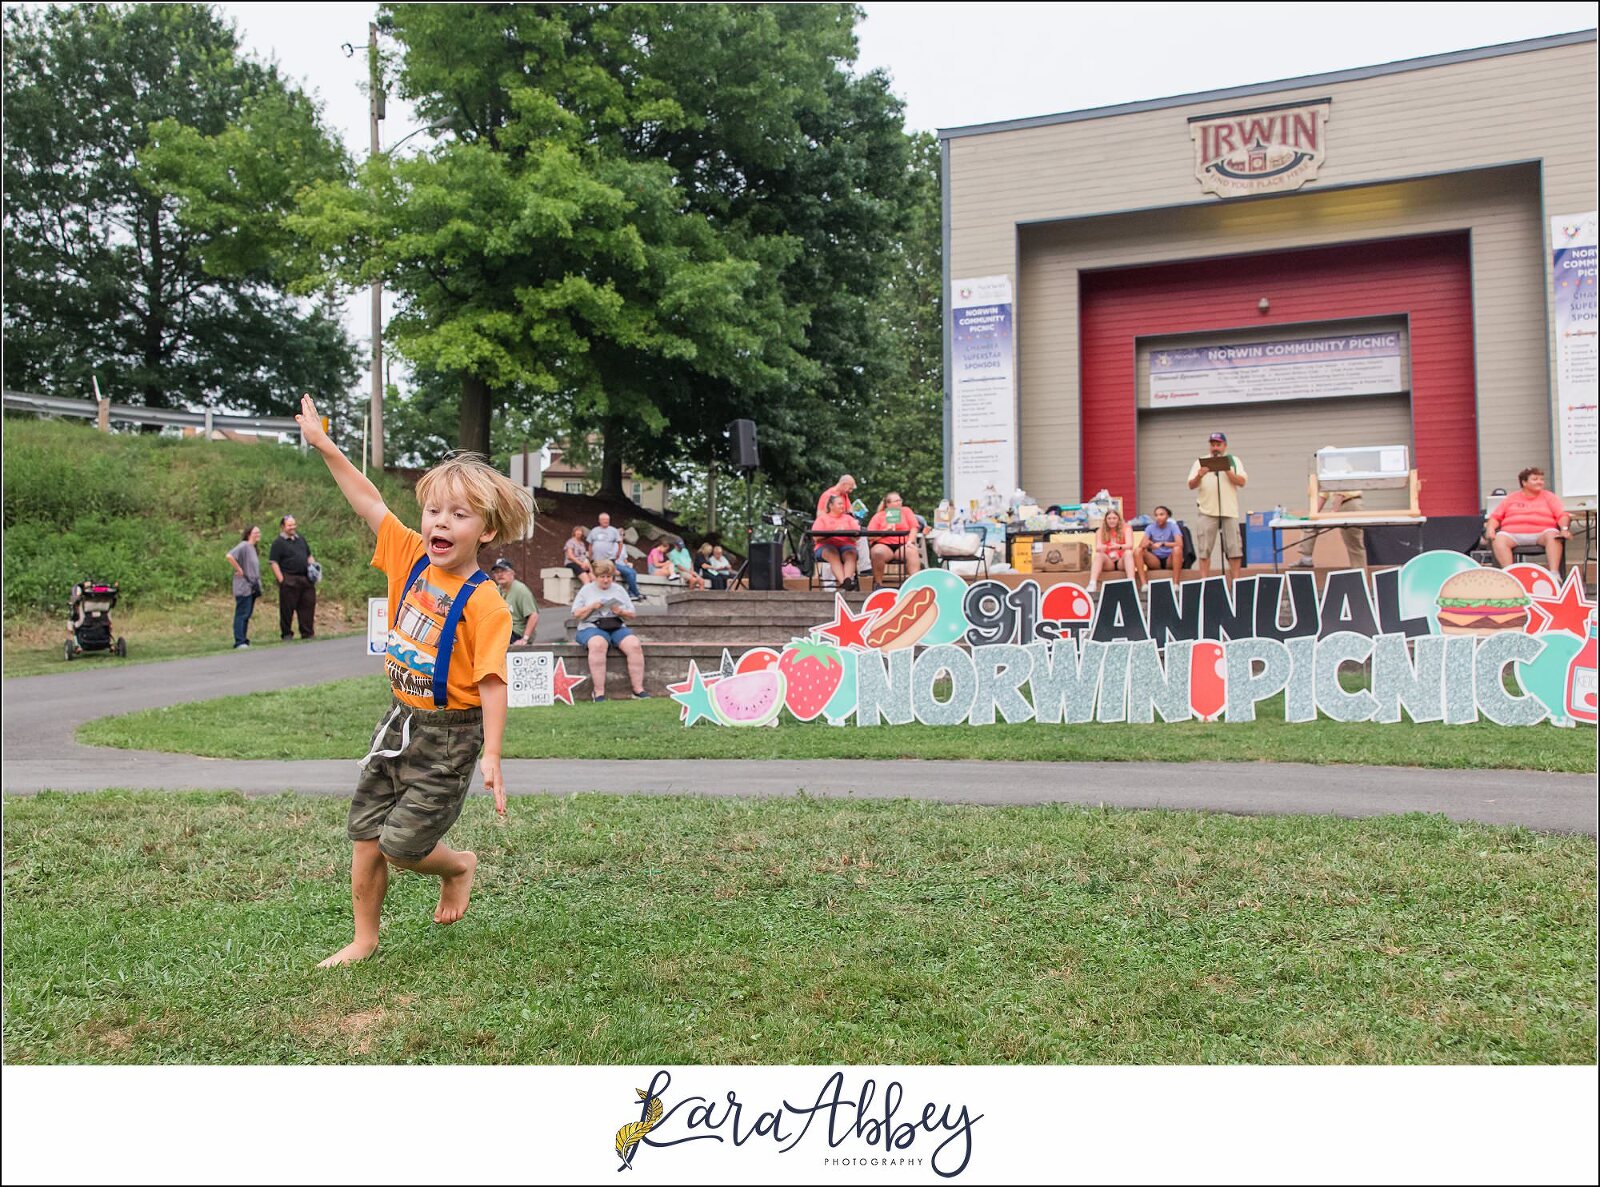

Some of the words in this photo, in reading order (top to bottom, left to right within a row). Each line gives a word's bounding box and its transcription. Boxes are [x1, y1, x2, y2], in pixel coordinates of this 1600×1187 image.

[1200, 110, 1318, 164] IRWIN
[959, 315, 1005, 326] COMMUNITY
[965, 307, 998, 317] NORWIN
[969, 324, 995, 333] PICNIC
[1208, 347, 1263, 360] NORWIN
[1266, 340, 1346, 356] COMMUNITY
[1349, 336, 1395, 349] PICNIC
[964, 360, 1001, 370] SPONSORS
[1091, 567, 1431, 649] ANNUAL
[857, 638, 1194, 727] NORWIN
[1224, 631, 1549, 726] PICNIC
